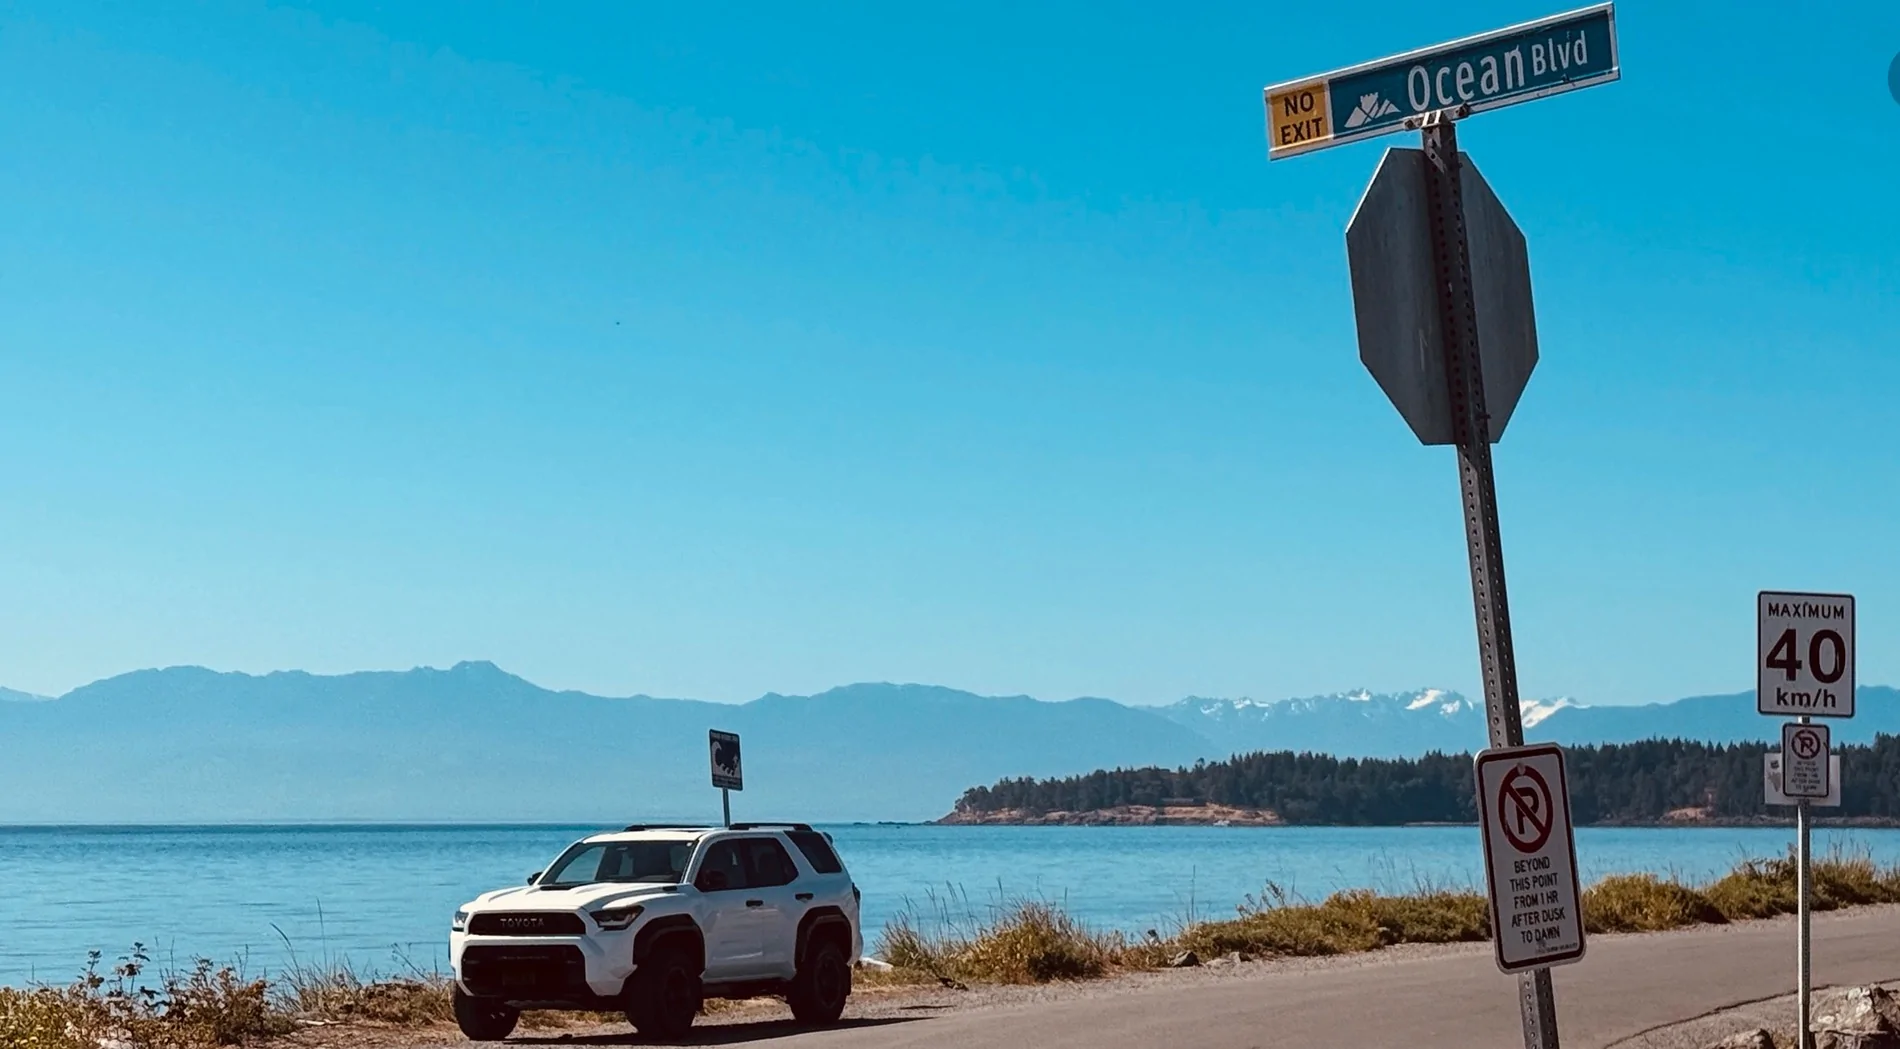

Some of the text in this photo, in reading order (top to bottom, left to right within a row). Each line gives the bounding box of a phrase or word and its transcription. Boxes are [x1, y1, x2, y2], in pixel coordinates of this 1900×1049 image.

[1408, 30, 1587, 111] Ocean Blvd
[1284, 92, 1314, 117] NO
[1281, 117, 1323, 145] EXIT
[1768, 602, 1845, 620] MAXIMUM
[1766, 628, 1846, 684] 40
[1776, 687, 1837, 708] km/h
[1514, 856, 1550, 874] BEYOND
[1509, 873, 1558, 892] THIS POINT
[1514, 890, 1559, 909] FROM 1 HR
[500, 917, 545, 928] TOYOTA
[1511, 907, 1566, 928] AFTER DUSK
[1521, 926, 1561, 944] TO DAWN
